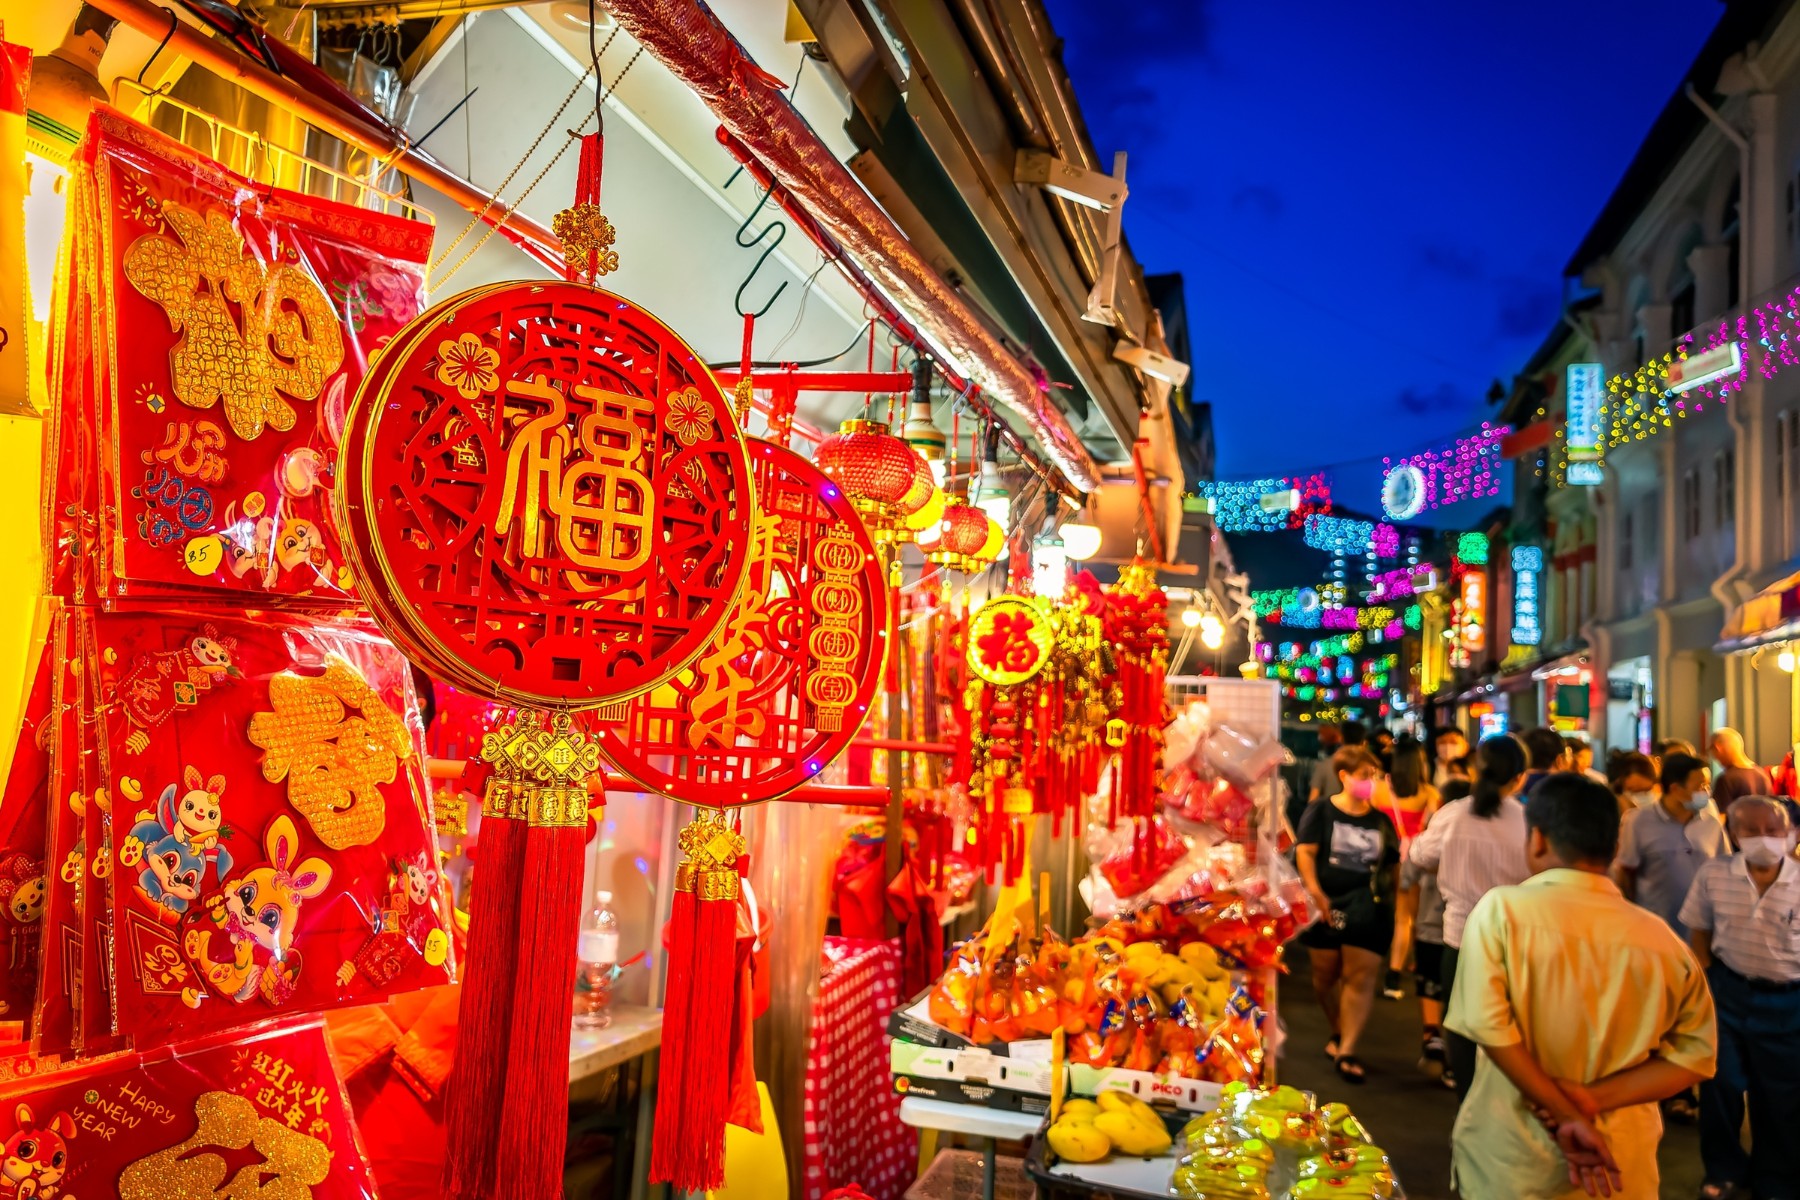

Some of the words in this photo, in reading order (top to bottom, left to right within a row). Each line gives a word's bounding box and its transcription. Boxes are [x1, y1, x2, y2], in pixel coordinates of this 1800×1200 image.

[494, 374, 655, 572] 福
[977, 610, 1039, 672] 福
[552, 747, 570, 765] 旺
[17, 1060, 31, 1074] 福
[251, 1051, 330, 1115] 红红火火
[119, 1081, 176, 1124] HAPPY
[1152, 1081, 1183, 1096] PICO
[73, 1106, 117, 1141] YEAR
[97, 1099, 142, 1129] NEW
[256, 1087, 306, 1129] 过大年
